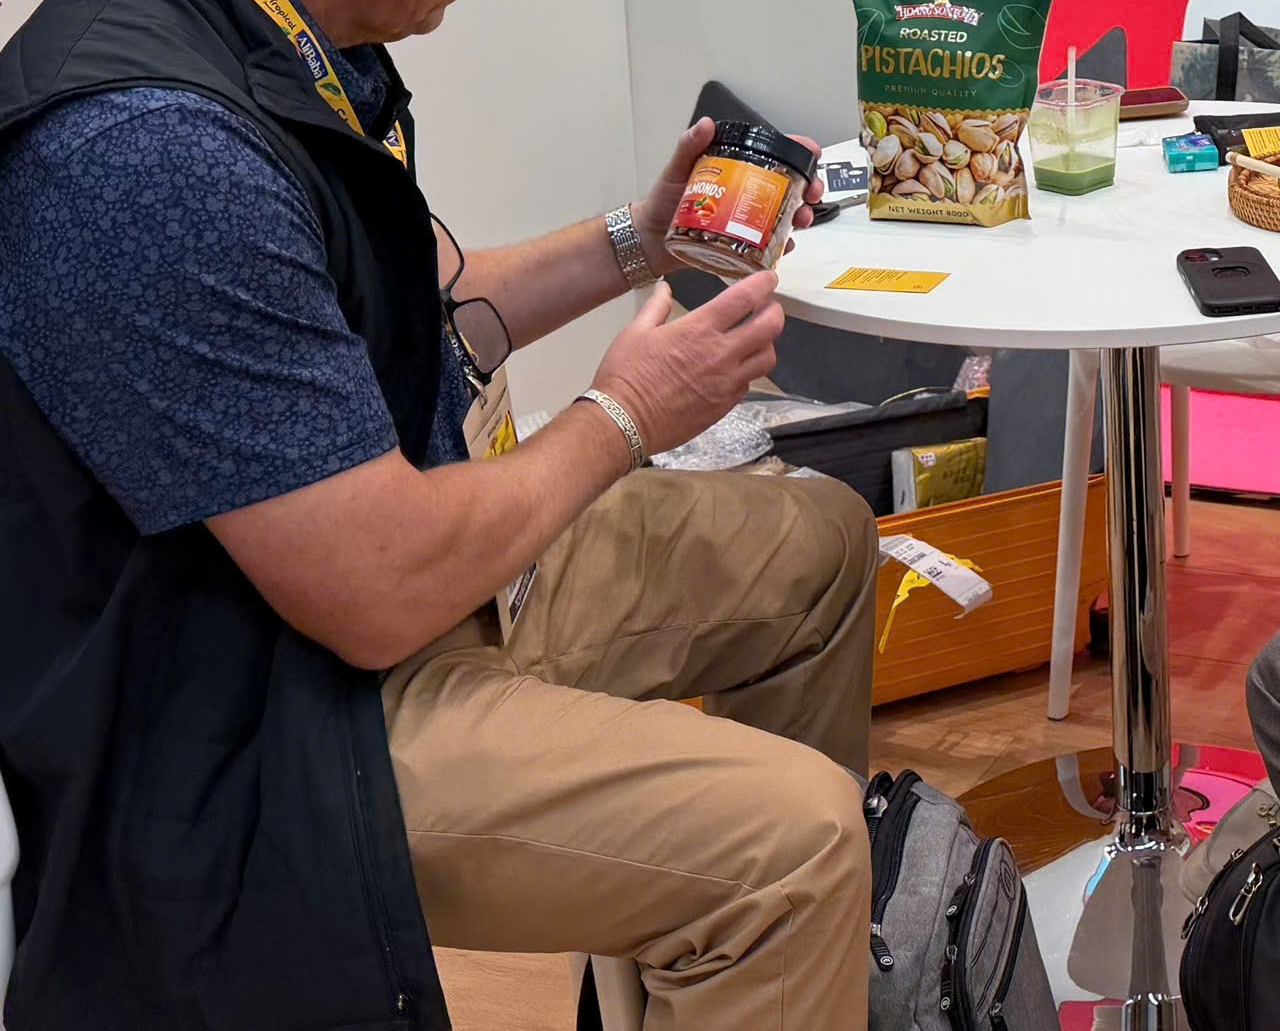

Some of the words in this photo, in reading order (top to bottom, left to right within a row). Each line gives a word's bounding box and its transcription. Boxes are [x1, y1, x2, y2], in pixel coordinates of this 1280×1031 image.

[899, 27, 968, 43] ROASTED
[888, 205, 905, 214] NET
[906, 206, 944, 216] WEIGHT
